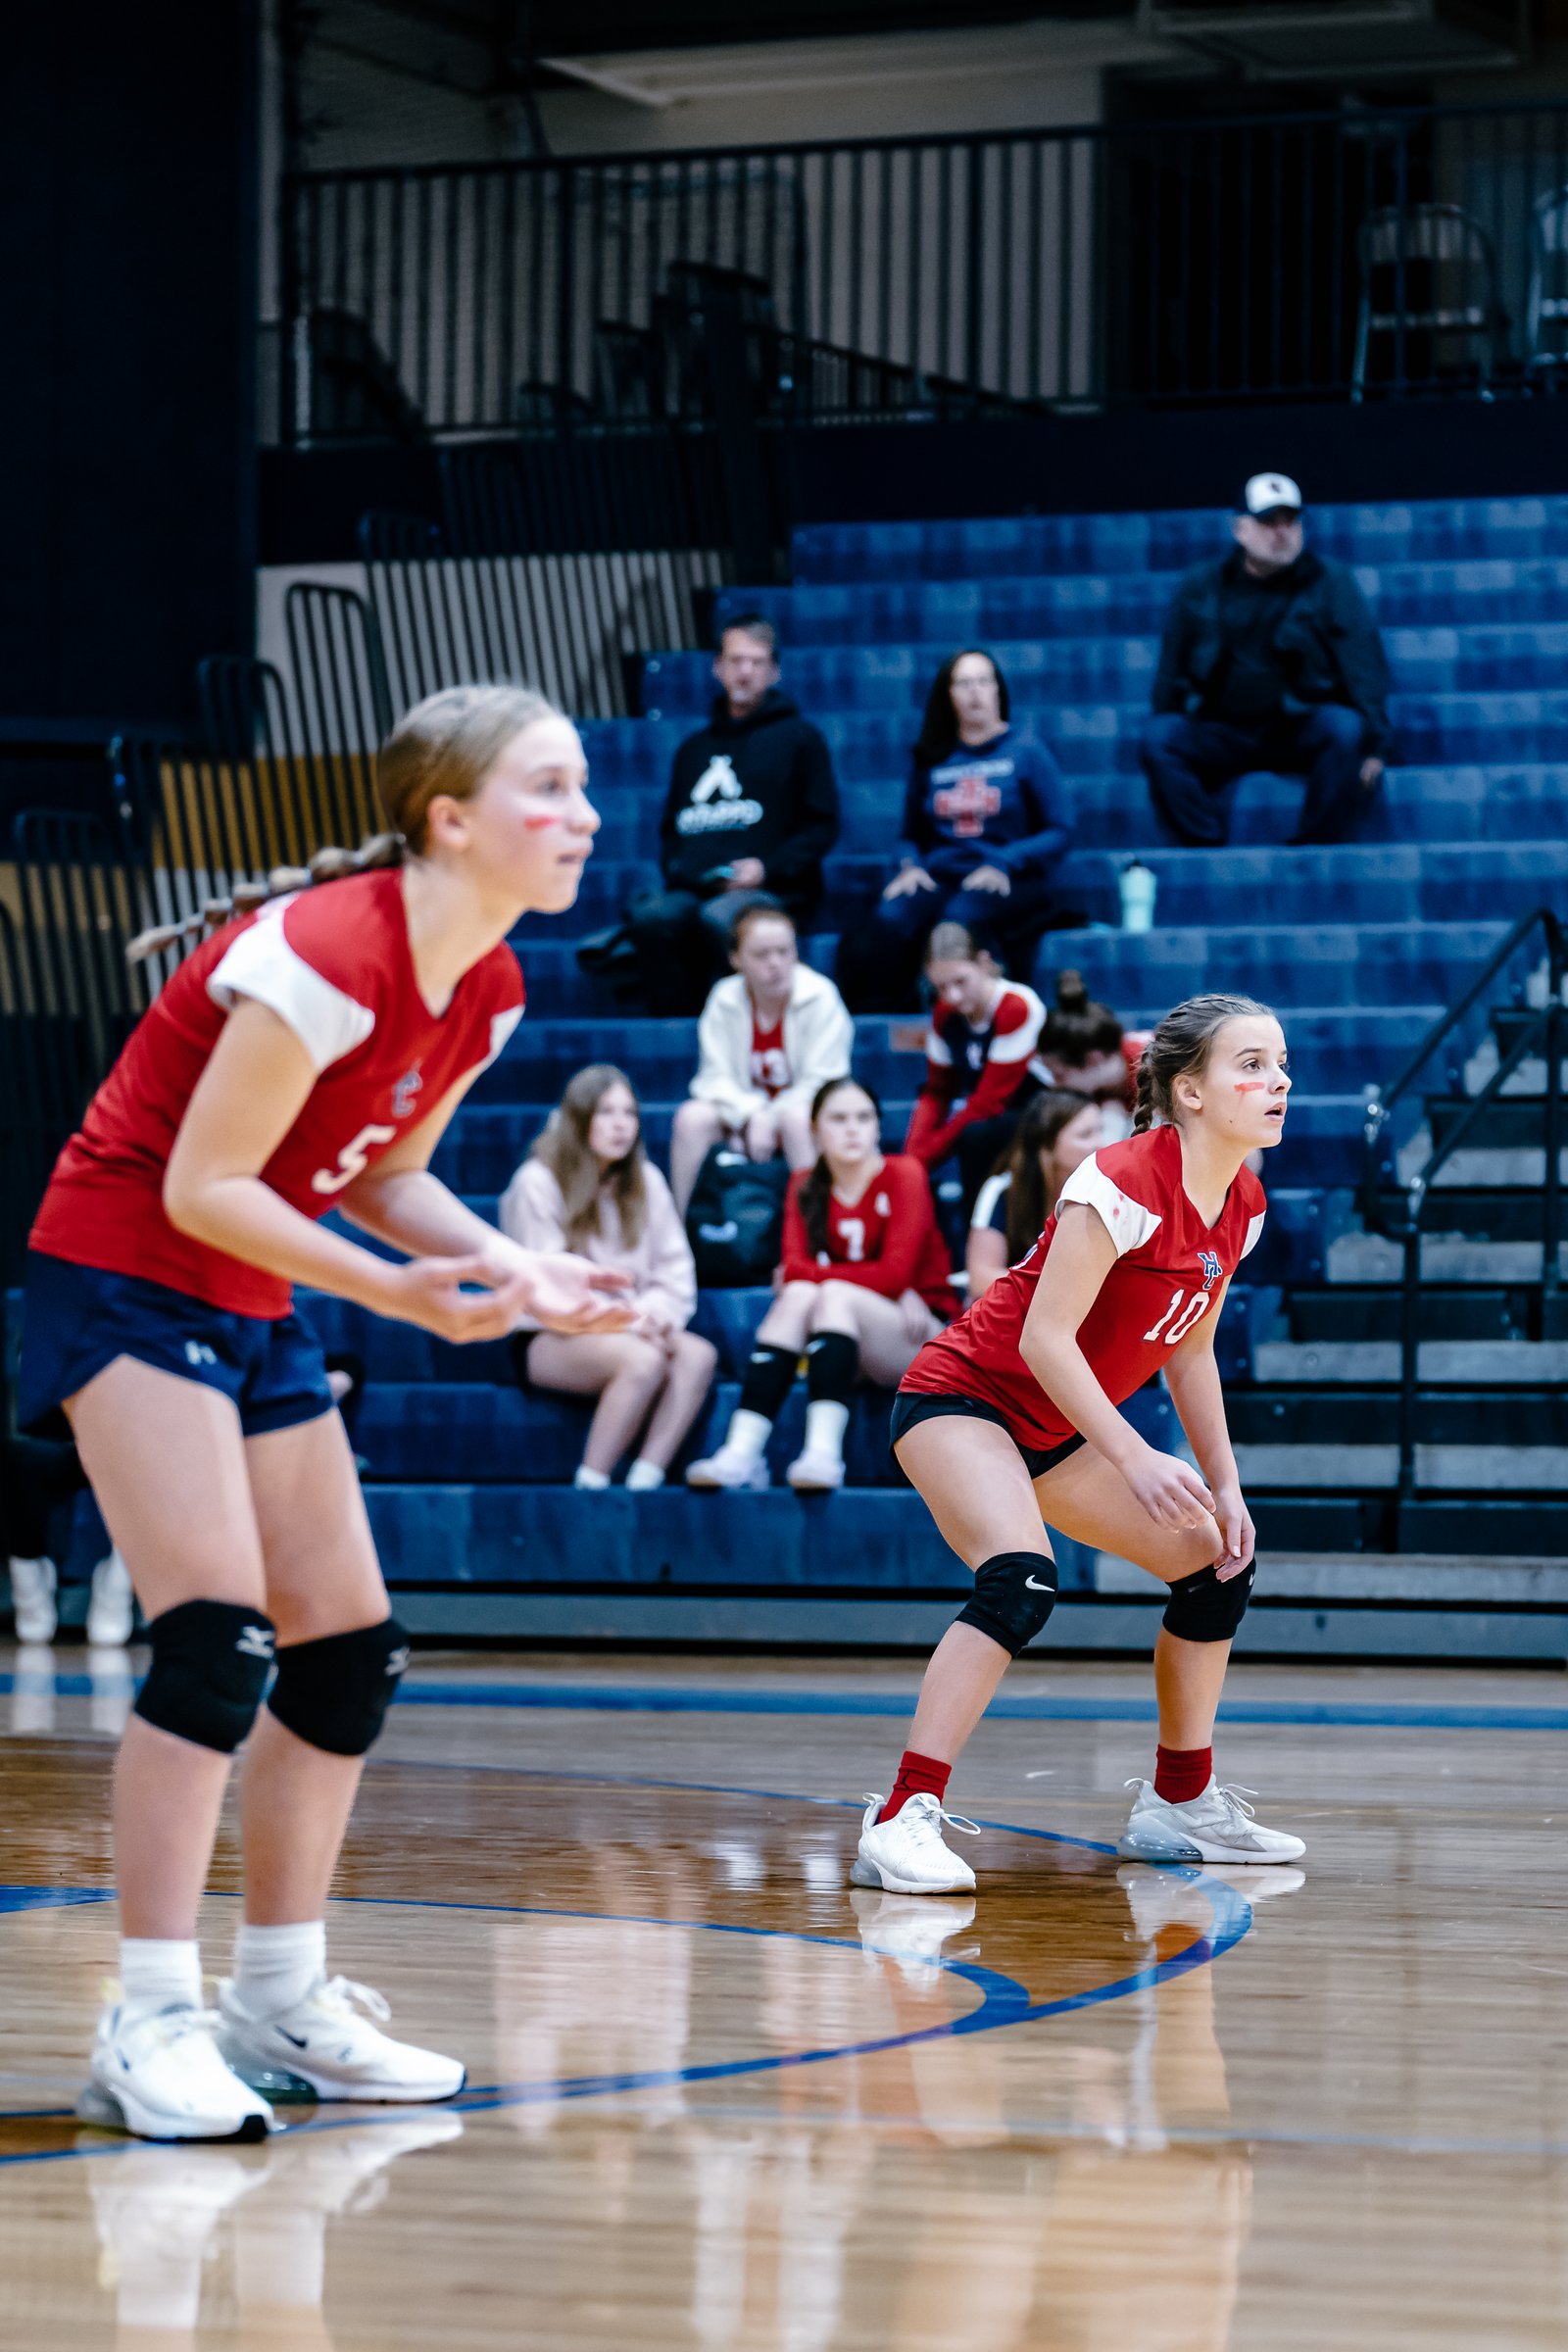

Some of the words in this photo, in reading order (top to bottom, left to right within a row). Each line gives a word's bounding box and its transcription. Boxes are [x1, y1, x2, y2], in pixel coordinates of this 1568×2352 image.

[312, 1124, 395, 1194] 5
[839, 1219, 864, 1261] 7
[1142, 1289, 1210, 1345] 10
